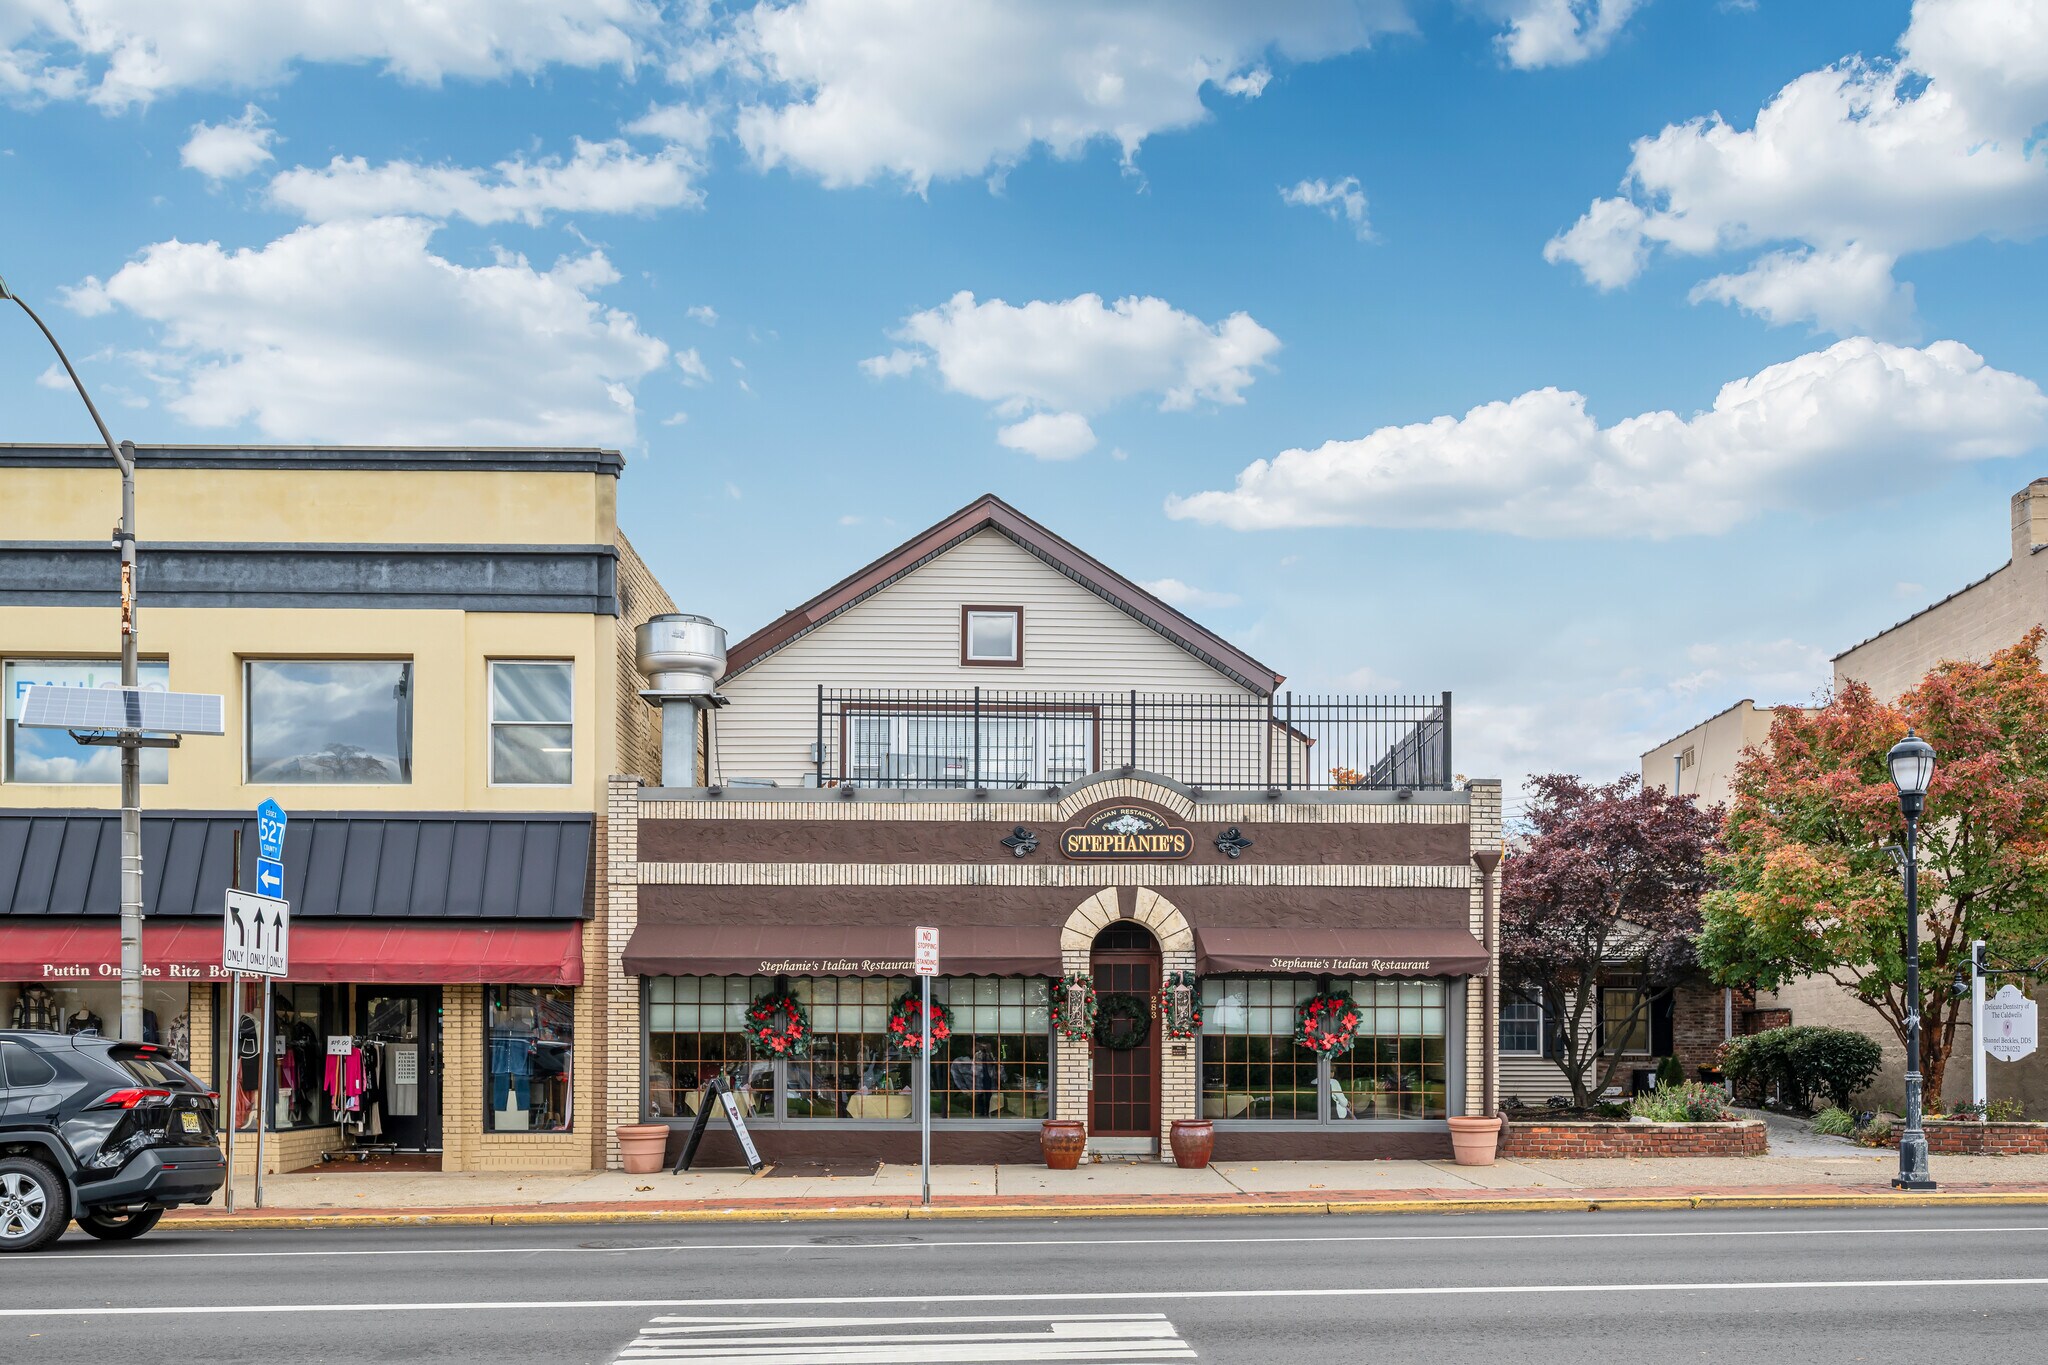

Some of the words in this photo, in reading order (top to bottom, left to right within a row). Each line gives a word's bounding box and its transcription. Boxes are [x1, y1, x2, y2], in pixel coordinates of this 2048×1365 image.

[1091, 810, 1117, 826] ITALIAN
[1120, 809, 1165, 827] RESTAURANT
[260, 817, 285, 845] 527
[1068, 834, 1185, 852] STEPHANIE'S
[923, 932, 932, 941] NO
[917, 942, 937, 950] STOPPING
[227, 949, 244, 962] ONLY
[250, 952, 266, 965] ONLY
[270, 955, 284, 968] ONLY
[1269, 957, 1329, 970] Stephanie's
[1332, 958, 1369, 970] Italian
[1371, 959, 1430, 972] Restaurant
[42, 964, 90, 977] Puttin
[98, 963, 121, 976] On
[169, 964, 200, 977] Ritz
[758, 959, 818, 974] Stephanie's
[821, 959, 858, 971] Italian
[861, 959, 915, 972] Restauran
[1984, 1003, 2002, 1011] Delicate
[2003, 1003, 2023, 1011] Dentistry
